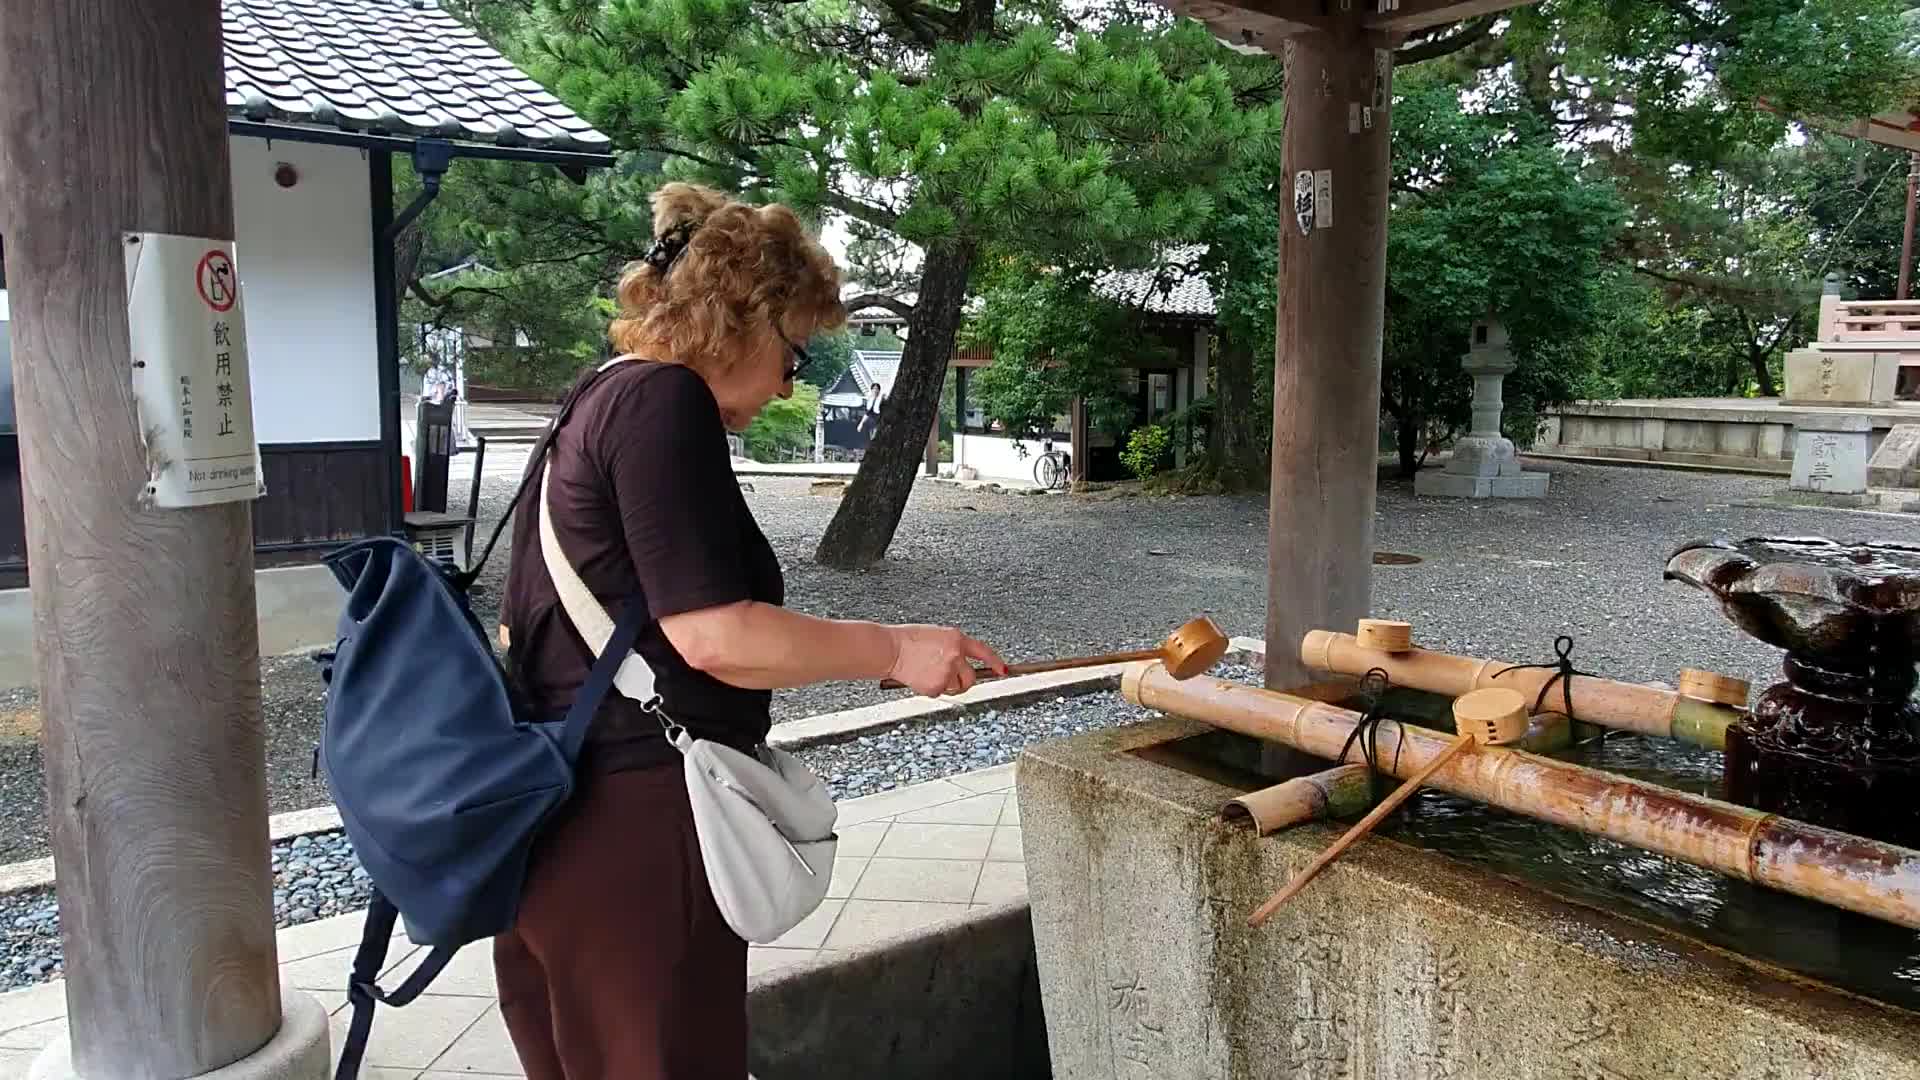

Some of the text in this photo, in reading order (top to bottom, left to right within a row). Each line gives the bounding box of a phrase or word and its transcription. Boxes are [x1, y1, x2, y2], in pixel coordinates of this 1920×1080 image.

[213, 321, 234, 437] 飲用禁止
[189, 469, 206, 481] Not
